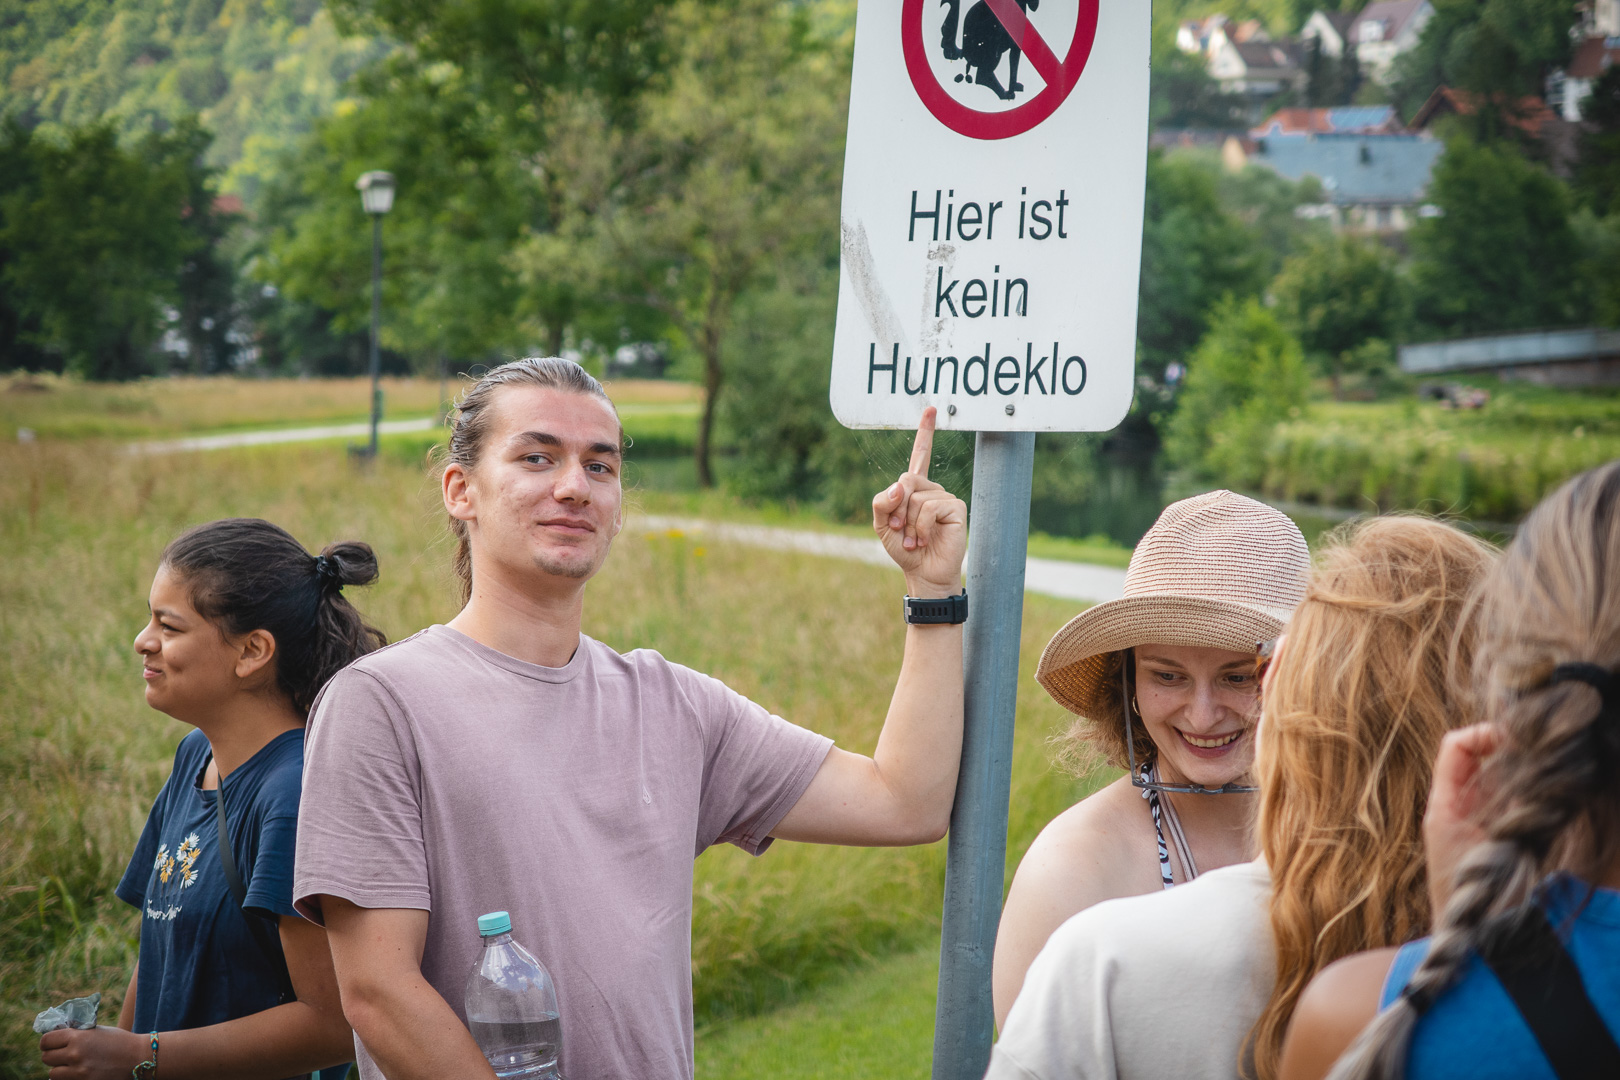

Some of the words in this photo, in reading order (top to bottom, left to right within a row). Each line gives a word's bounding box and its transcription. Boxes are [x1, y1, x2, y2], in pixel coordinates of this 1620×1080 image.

[908, 189, 1004, 241] Hier
[1018, 186, 1070, 240] ist
[935, 264, 1029, 318] kein
[867, 341, 1087, 396] Hundeklo
